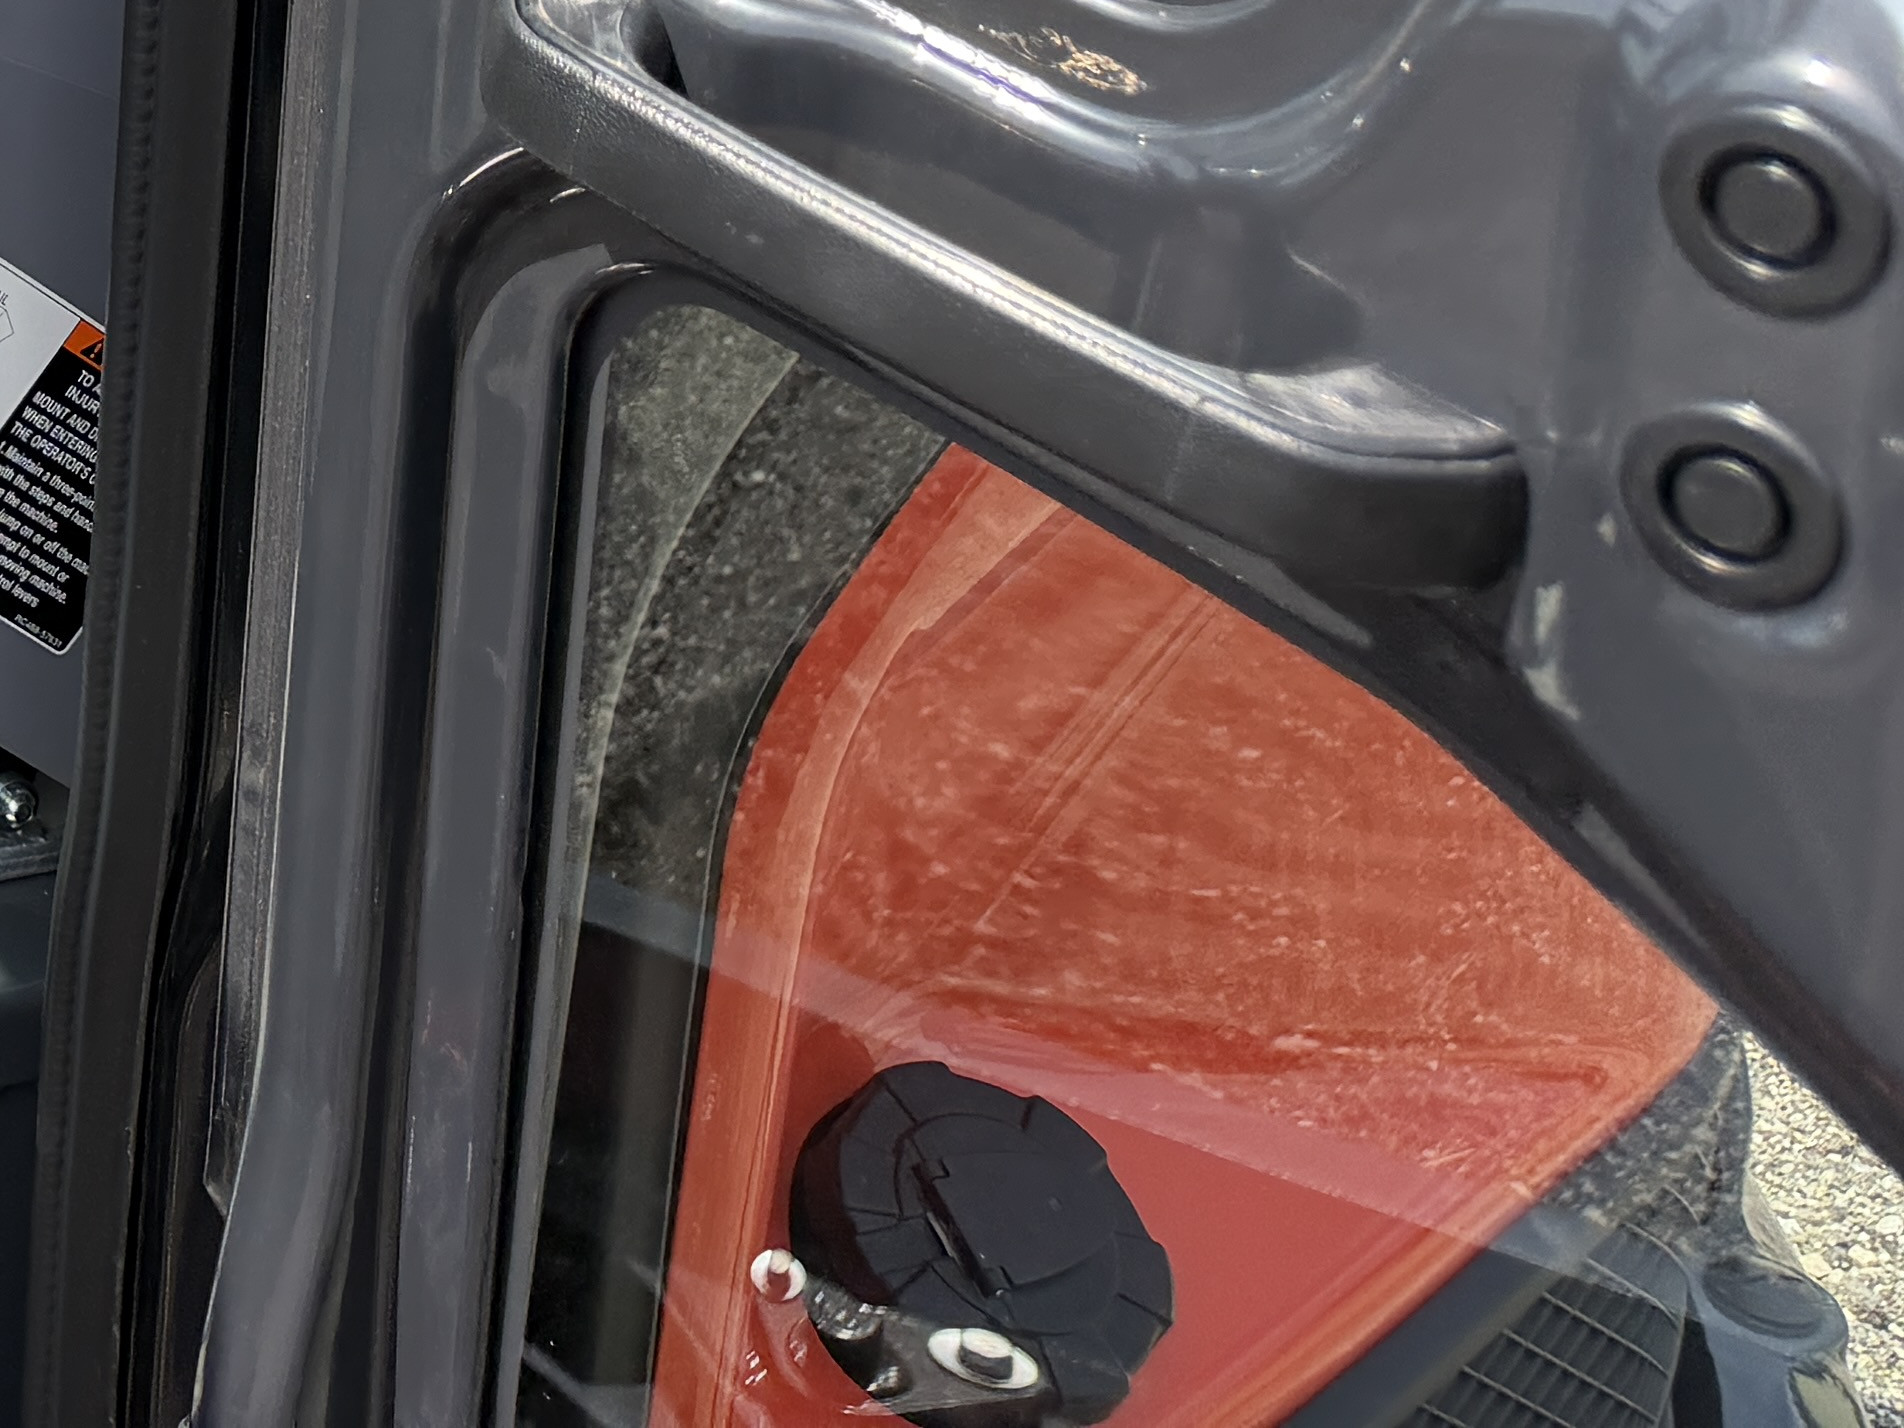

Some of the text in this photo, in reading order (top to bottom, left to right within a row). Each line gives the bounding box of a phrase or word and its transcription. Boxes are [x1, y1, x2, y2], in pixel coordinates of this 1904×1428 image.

[77, 369, 95, 388] TO
[32, 390, 91, 434] MOUNT AND
[64, 384, 101, 415] INJUR
[10, 420, 34, 443] THE
[21, 405, 54, 433] WHEN
[41, 471, 52, 483] a
[3, 489, 22, 509] the
[12, 473, 31, 492] the
[28, 485, 56, 508] steps
[53, 500, 75, 519] and
[19, 524, 35, 540] on
[32, 531, 46, 546] or
[42, 539, 61, 555] off
[56, 545, 74, 564] the
[18, 545, 31, 560] to
[28, 553, 60, 577] mount
[56, 571, 70, 584] or
[11, 584, 41, 609] levers
